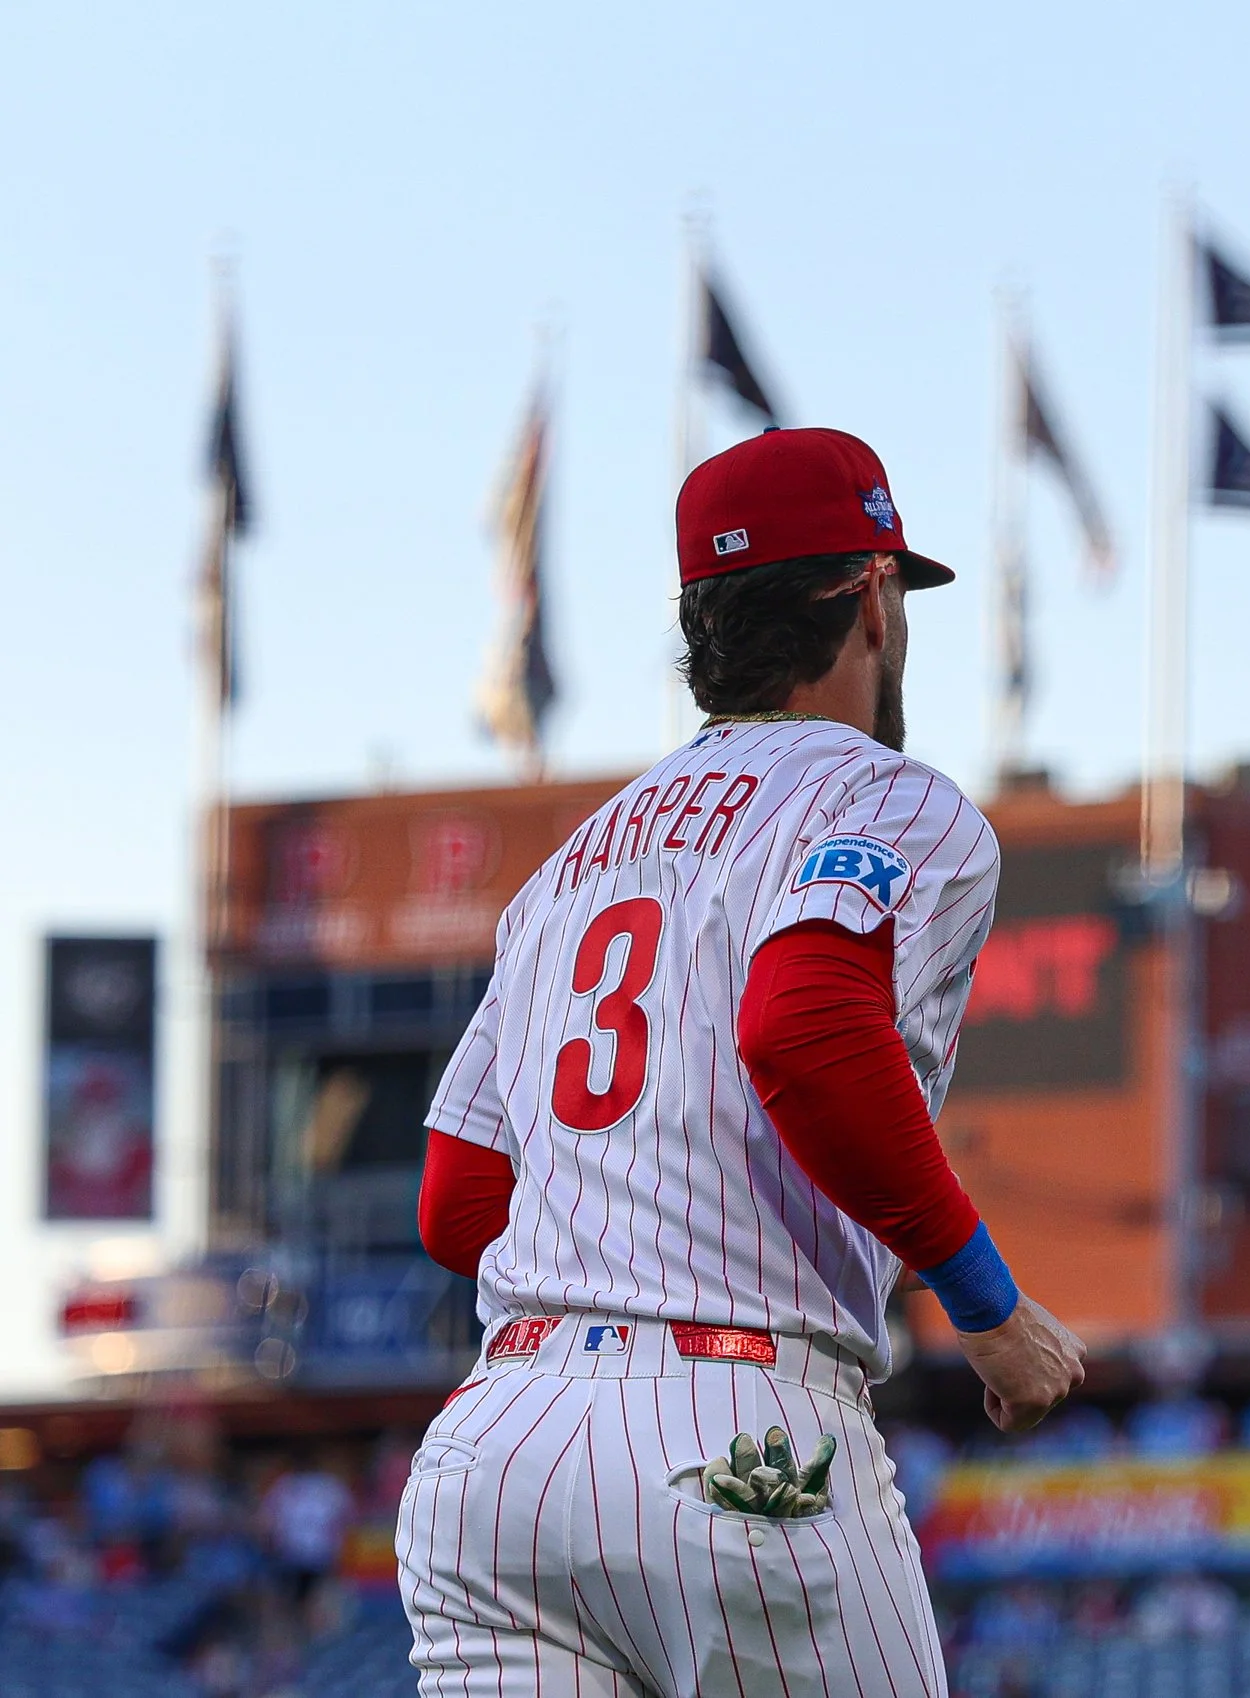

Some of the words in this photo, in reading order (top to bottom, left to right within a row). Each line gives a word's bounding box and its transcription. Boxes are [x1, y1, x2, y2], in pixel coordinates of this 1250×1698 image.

[554, 771, 760, 900] HARPER
[798, 849, 905, 907] IBX
[550, 896, 665, 1134] 3
